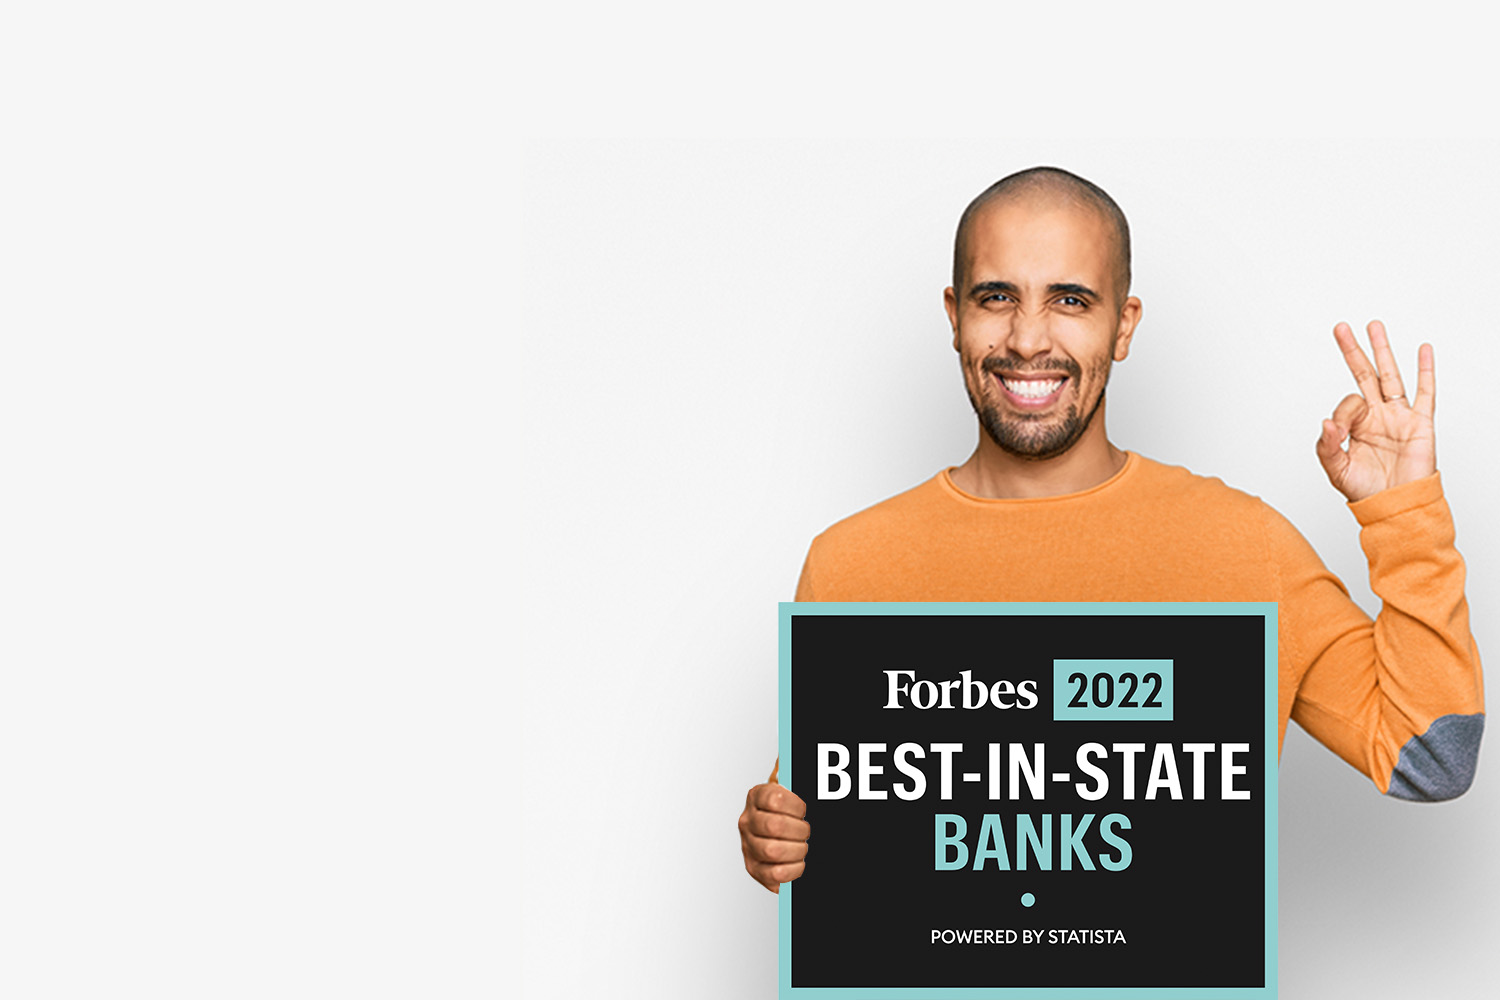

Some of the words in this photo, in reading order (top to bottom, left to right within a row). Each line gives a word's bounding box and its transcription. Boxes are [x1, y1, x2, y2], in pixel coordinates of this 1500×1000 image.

[883, 670, 1038, 709] Forbes
[1068, 673, 1162, 708] 2022
[818, 743, 1250, 801] BEST-IN-STATE
[935, 813, 1132, 871] BANKS
[932, 930, 1017, 944] POWERED
[1023, 930, 1044, 944] BY
[1049, 930, 1126, 944] STATISTA
